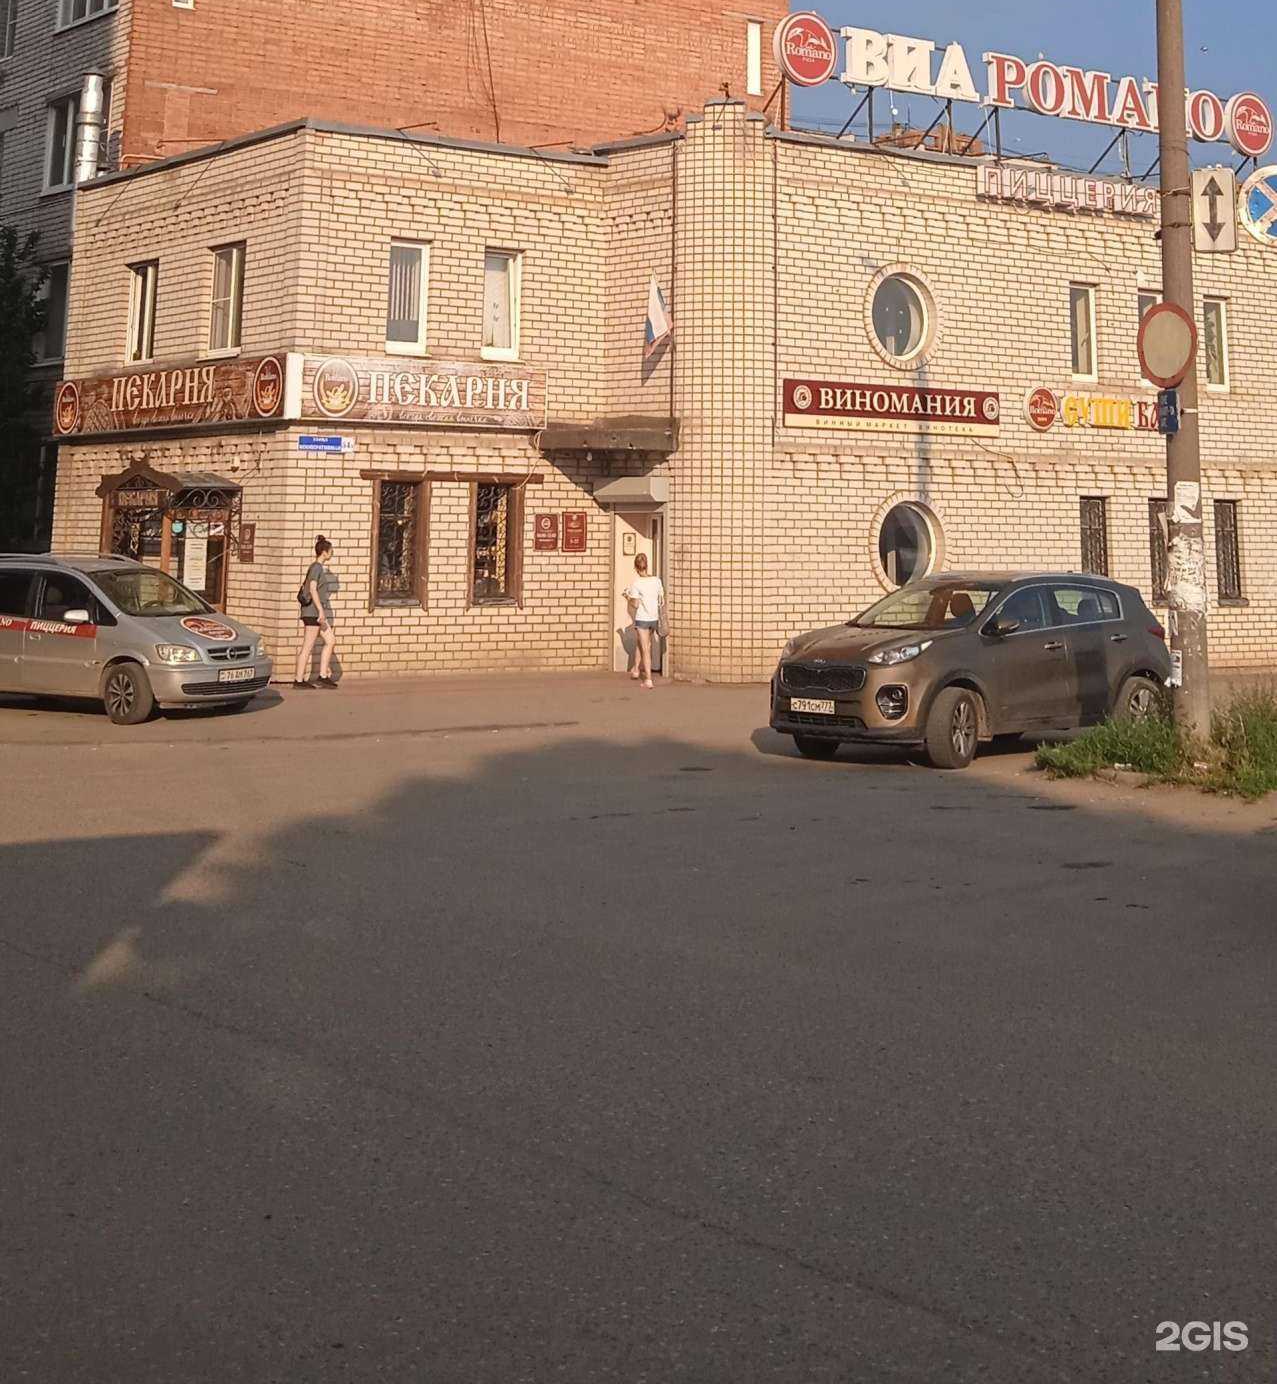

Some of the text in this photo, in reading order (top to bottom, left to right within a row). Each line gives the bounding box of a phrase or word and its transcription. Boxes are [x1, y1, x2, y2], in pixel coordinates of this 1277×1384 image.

[786, 41, 831, 61] Romano
[840, 26, 980, 102] ВИА
[1236, 118, 1270, 134] Romano
[984, 166, 1159, 215] ПИЦЦЕРИЯ
[111, 366, 216, 412] ПЕКАРНЯ
[367, 371, 531, 411] ПЕКАРНЯ
[819, 387, 977, 417] ВИНОМАНИЯ
[866, 421, 907, 429] МАРКЕТ
[1062, 395, 1159, 430] СУШИ БА
[0, 618, 13, 627] NO
[30, 621, 77, 634] ПИЦЦЕРИЯ
